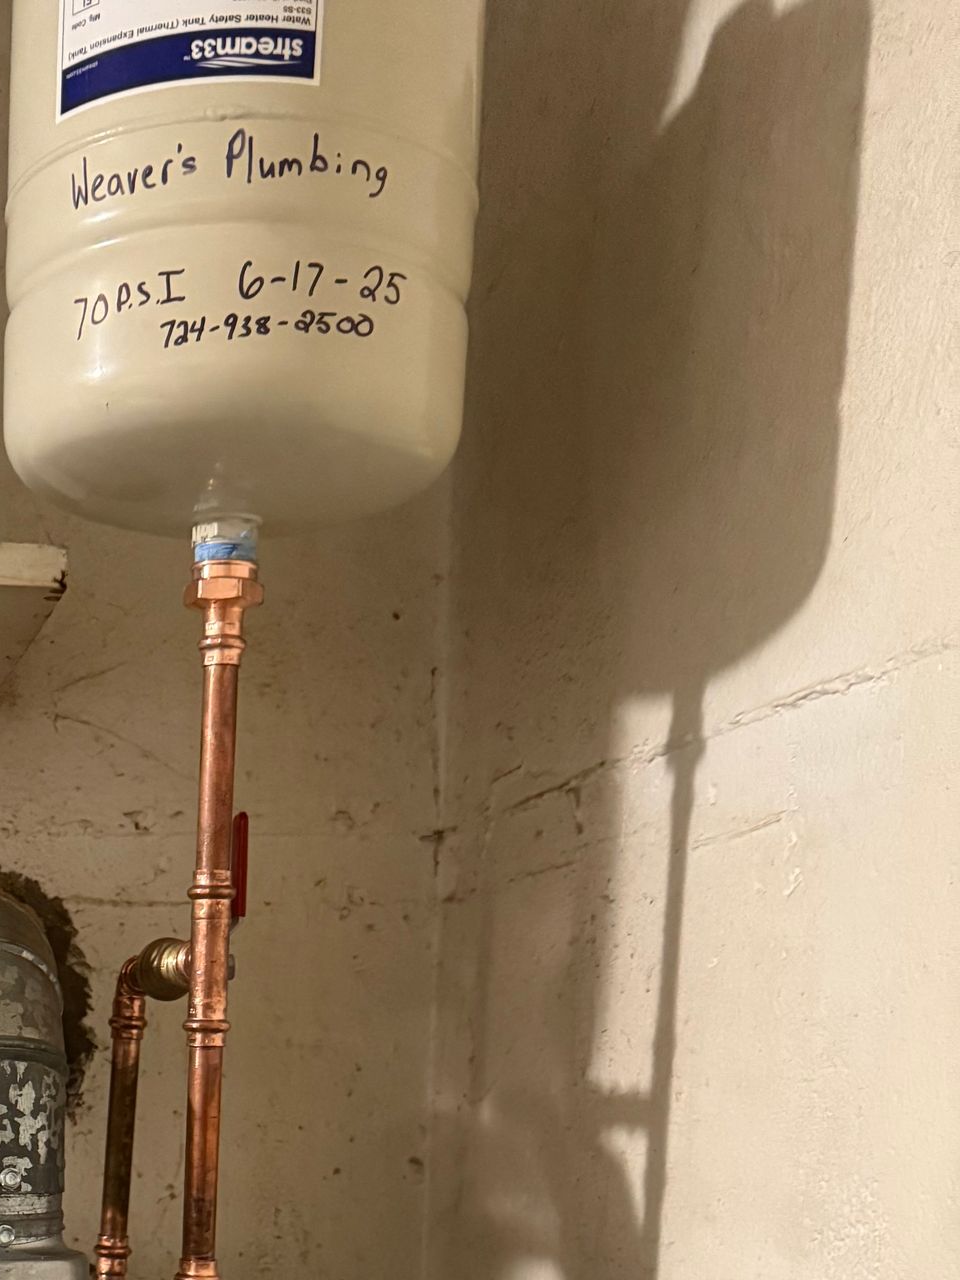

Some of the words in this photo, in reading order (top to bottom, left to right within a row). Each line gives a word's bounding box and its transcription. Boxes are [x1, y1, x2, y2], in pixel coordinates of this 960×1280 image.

[137, 19, 179, 38] (Thermal
[182, 16, 206, 27] Tank
[209, 14, 241, 24] Safety
[244, 14, 279, 24] Heater
[282, 14, 311, 26] Water
[90, 29, 134, 50] Expansion
[72, 143, 197, 209] Weaver's
[226, 128, 388, 197] Plumbing
[239, 260, 406, 305] 6-17-25
[160, 310, 374, 348] 724-938-2500
